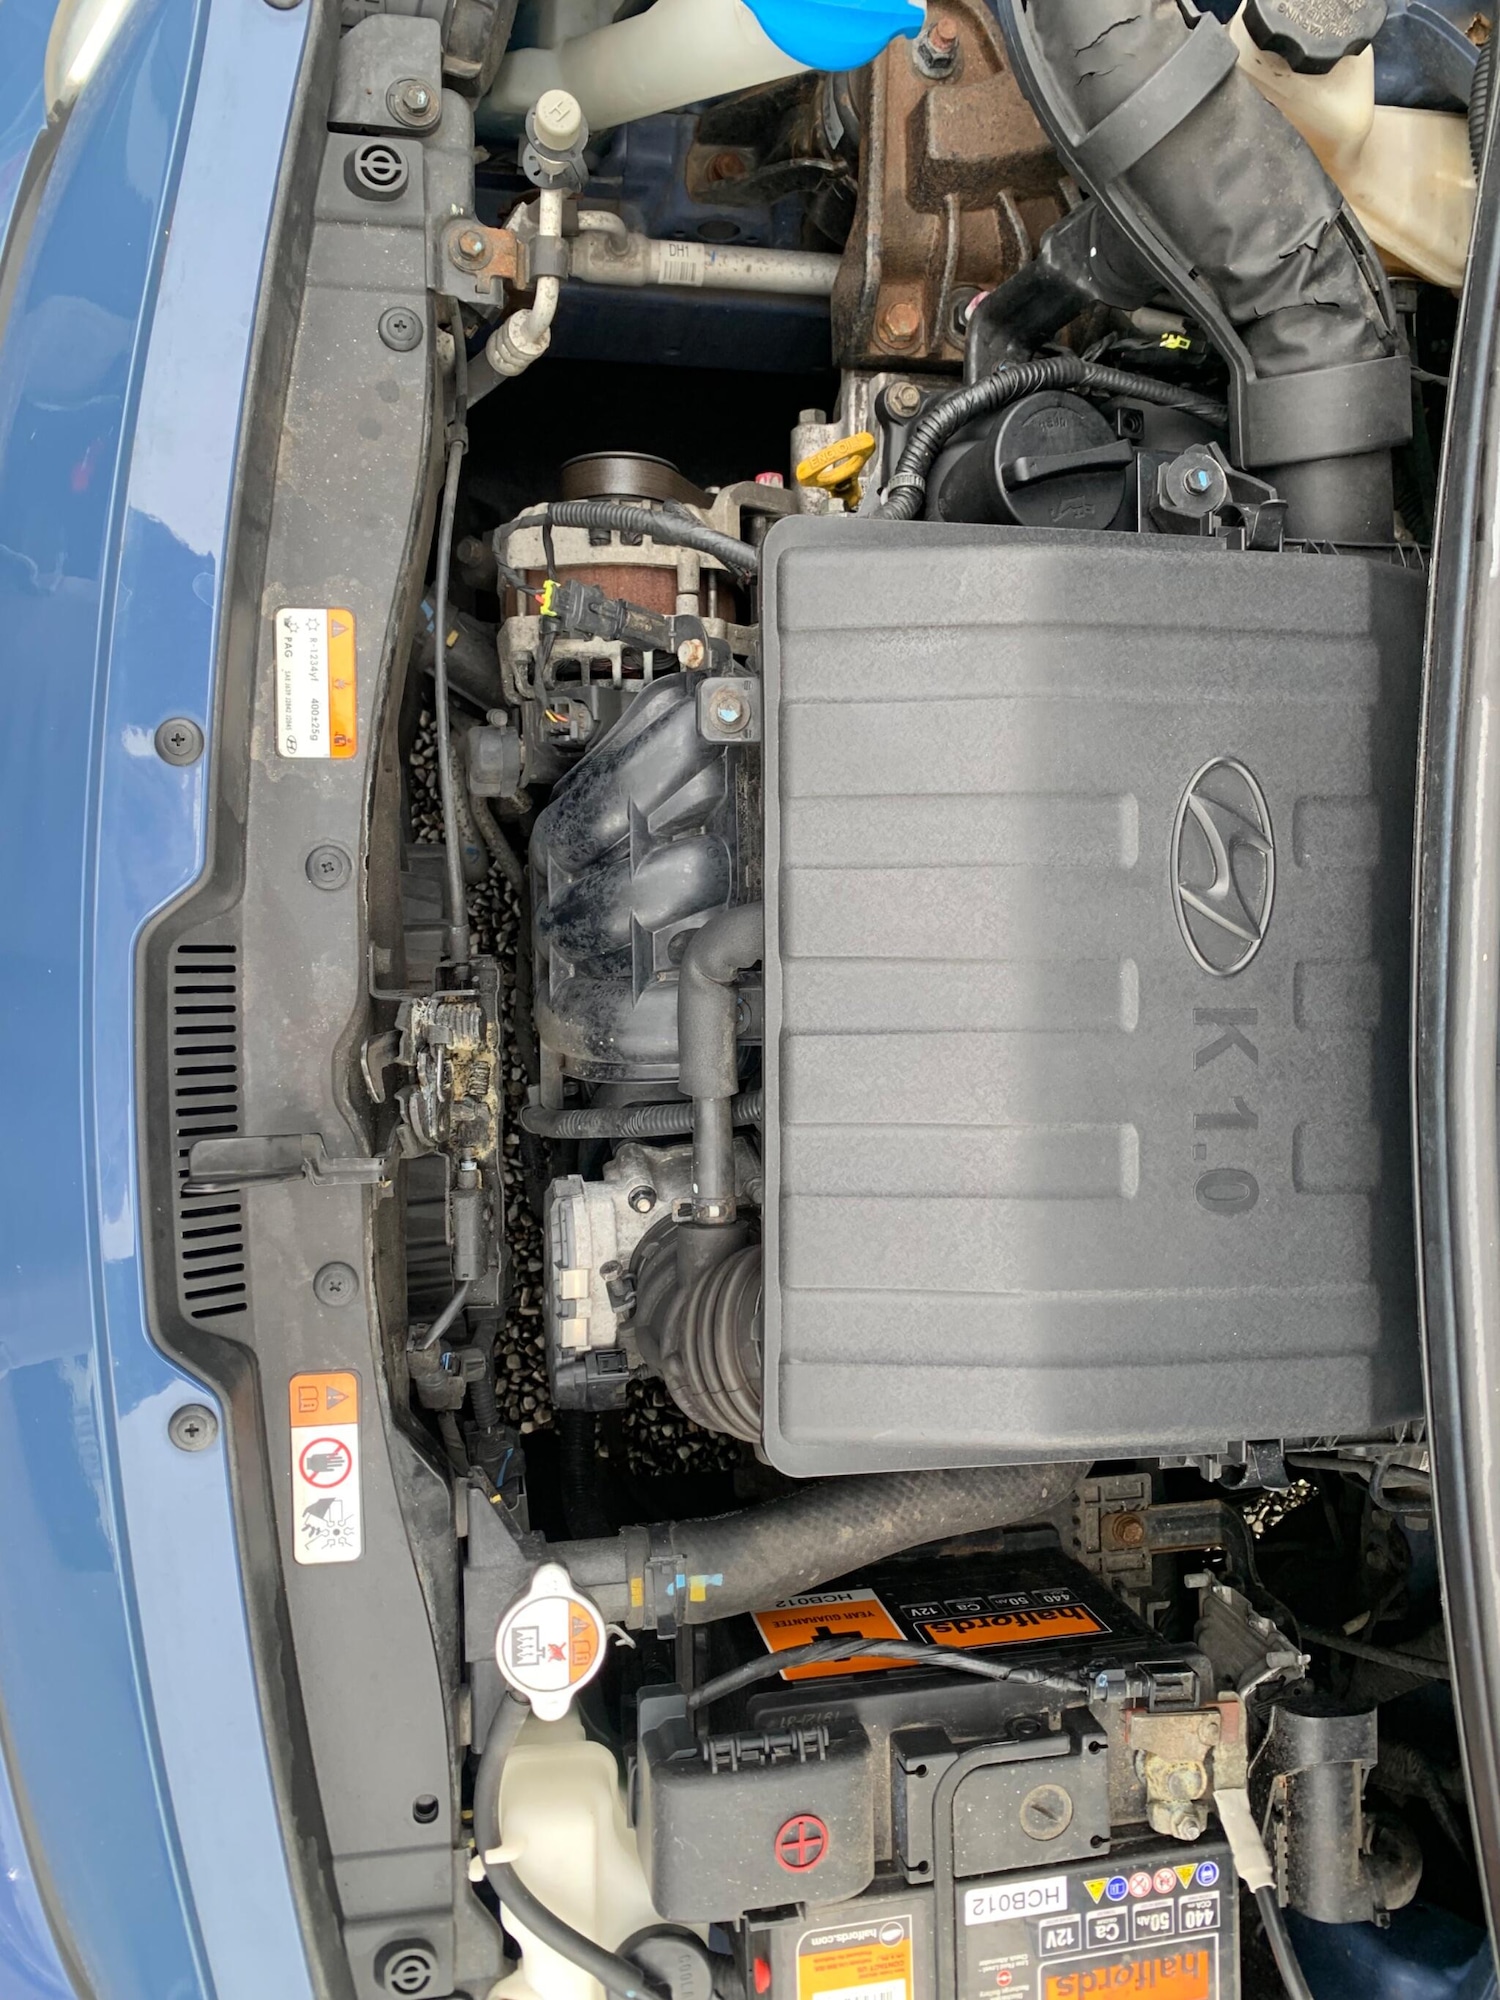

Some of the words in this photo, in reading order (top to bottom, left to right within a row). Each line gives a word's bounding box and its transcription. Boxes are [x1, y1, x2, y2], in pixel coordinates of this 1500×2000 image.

[669, 243, 690, 258] DH1
[809, 450, 836, 470] ENG
[284, 636, 293, 658] PAG
[308, 637, 320, 682] R-1234yf
[309, 698, 320, 741] 400±25g
[775, 1593, 852, 1608] HCB012
[956, 1603, 981, 1612] Ca
[1043, 1593, 1070, 1603] 440
[772, 1613, 842, 1628] GUARANTEE
[844, 1610, 875, 1621] YEAR
[910, 1606, 938, 1617] 12V
[929, 1606, 1085, 1635] halfords
[972, 1885, 1060, 1916] HCB012
[1185, 1908, 1214, 1929] 440
[811, 1928, 877, 1946] halfords.com
[1045, 1927, 1074, 1949] 12V
[1094, 1923, 1120, 1941] Ca
[1056, 1952, 1200, 2000] halfords
